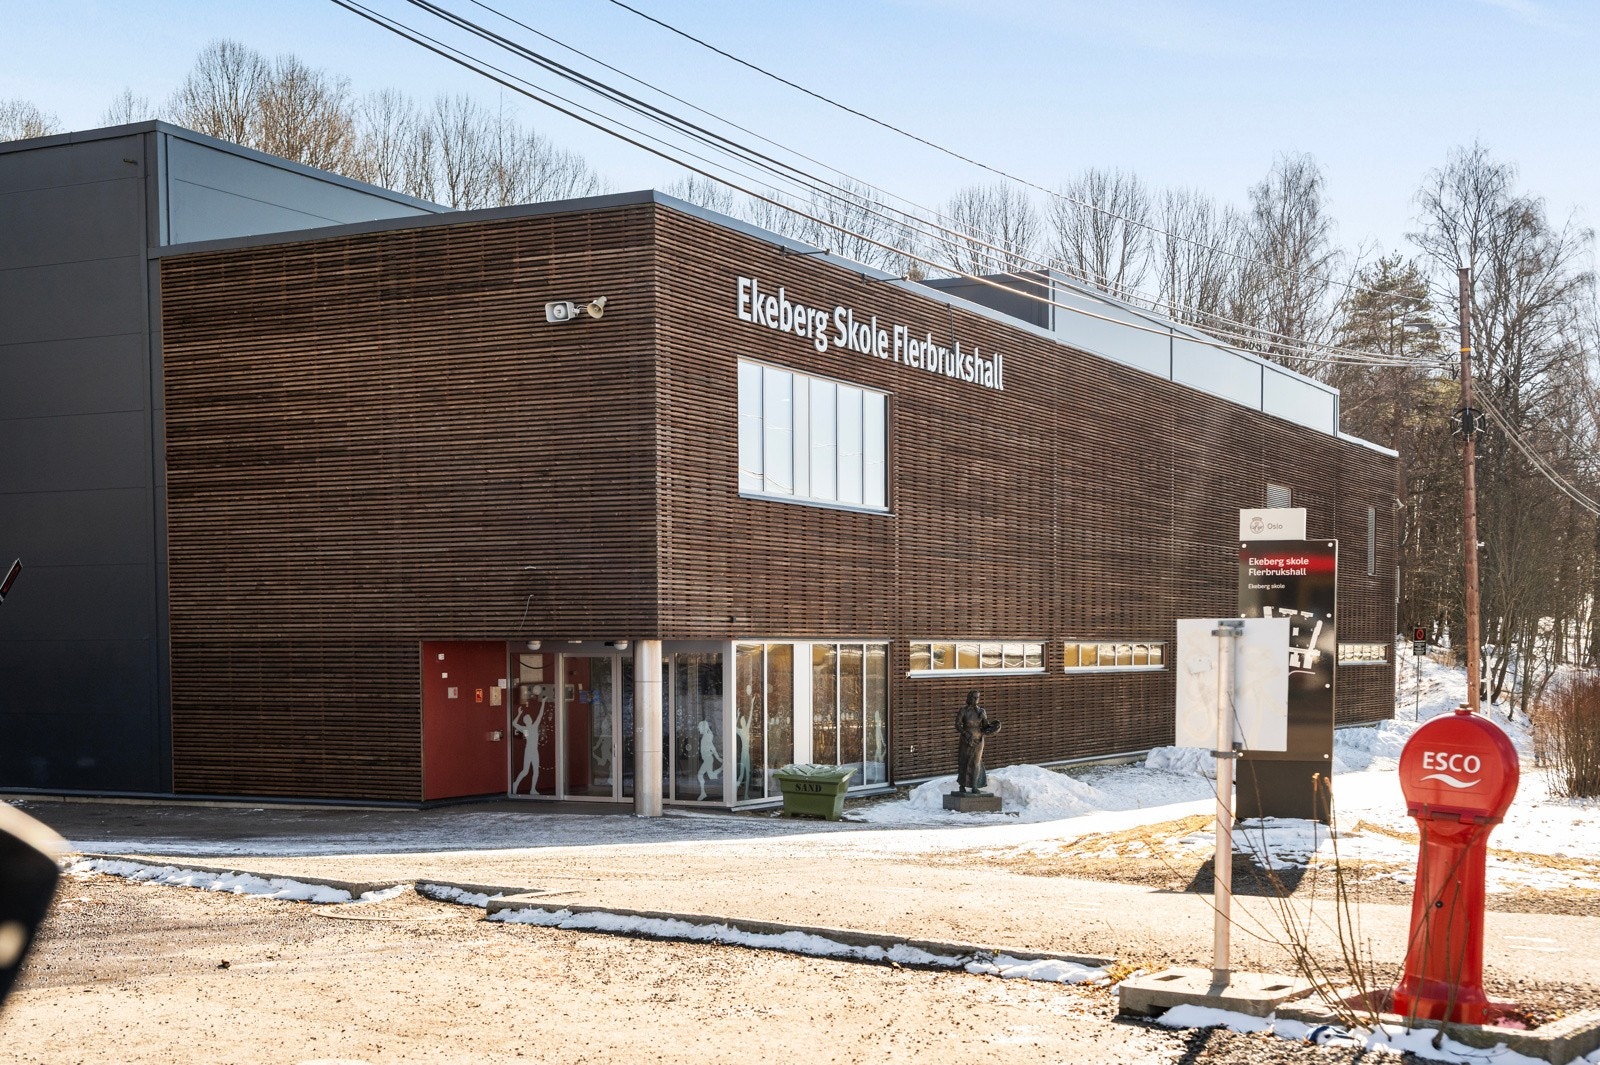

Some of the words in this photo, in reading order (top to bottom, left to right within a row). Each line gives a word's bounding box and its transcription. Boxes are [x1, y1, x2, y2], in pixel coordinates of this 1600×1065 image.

[737, 276, 829, 353] Ekeberg
[833, 306, 889, 360] Skole
[893, 324, 1004, 391] Flerbrukshall
[1248, 557, 1284, 567] Ekeberg
[1286, 557, 1309, 566] skole
[1249, 568, 1306, 576] Flerbrukshall
[1422, 751, 1481, 773] ESCO
[795, 783, 822, 793] SAND
